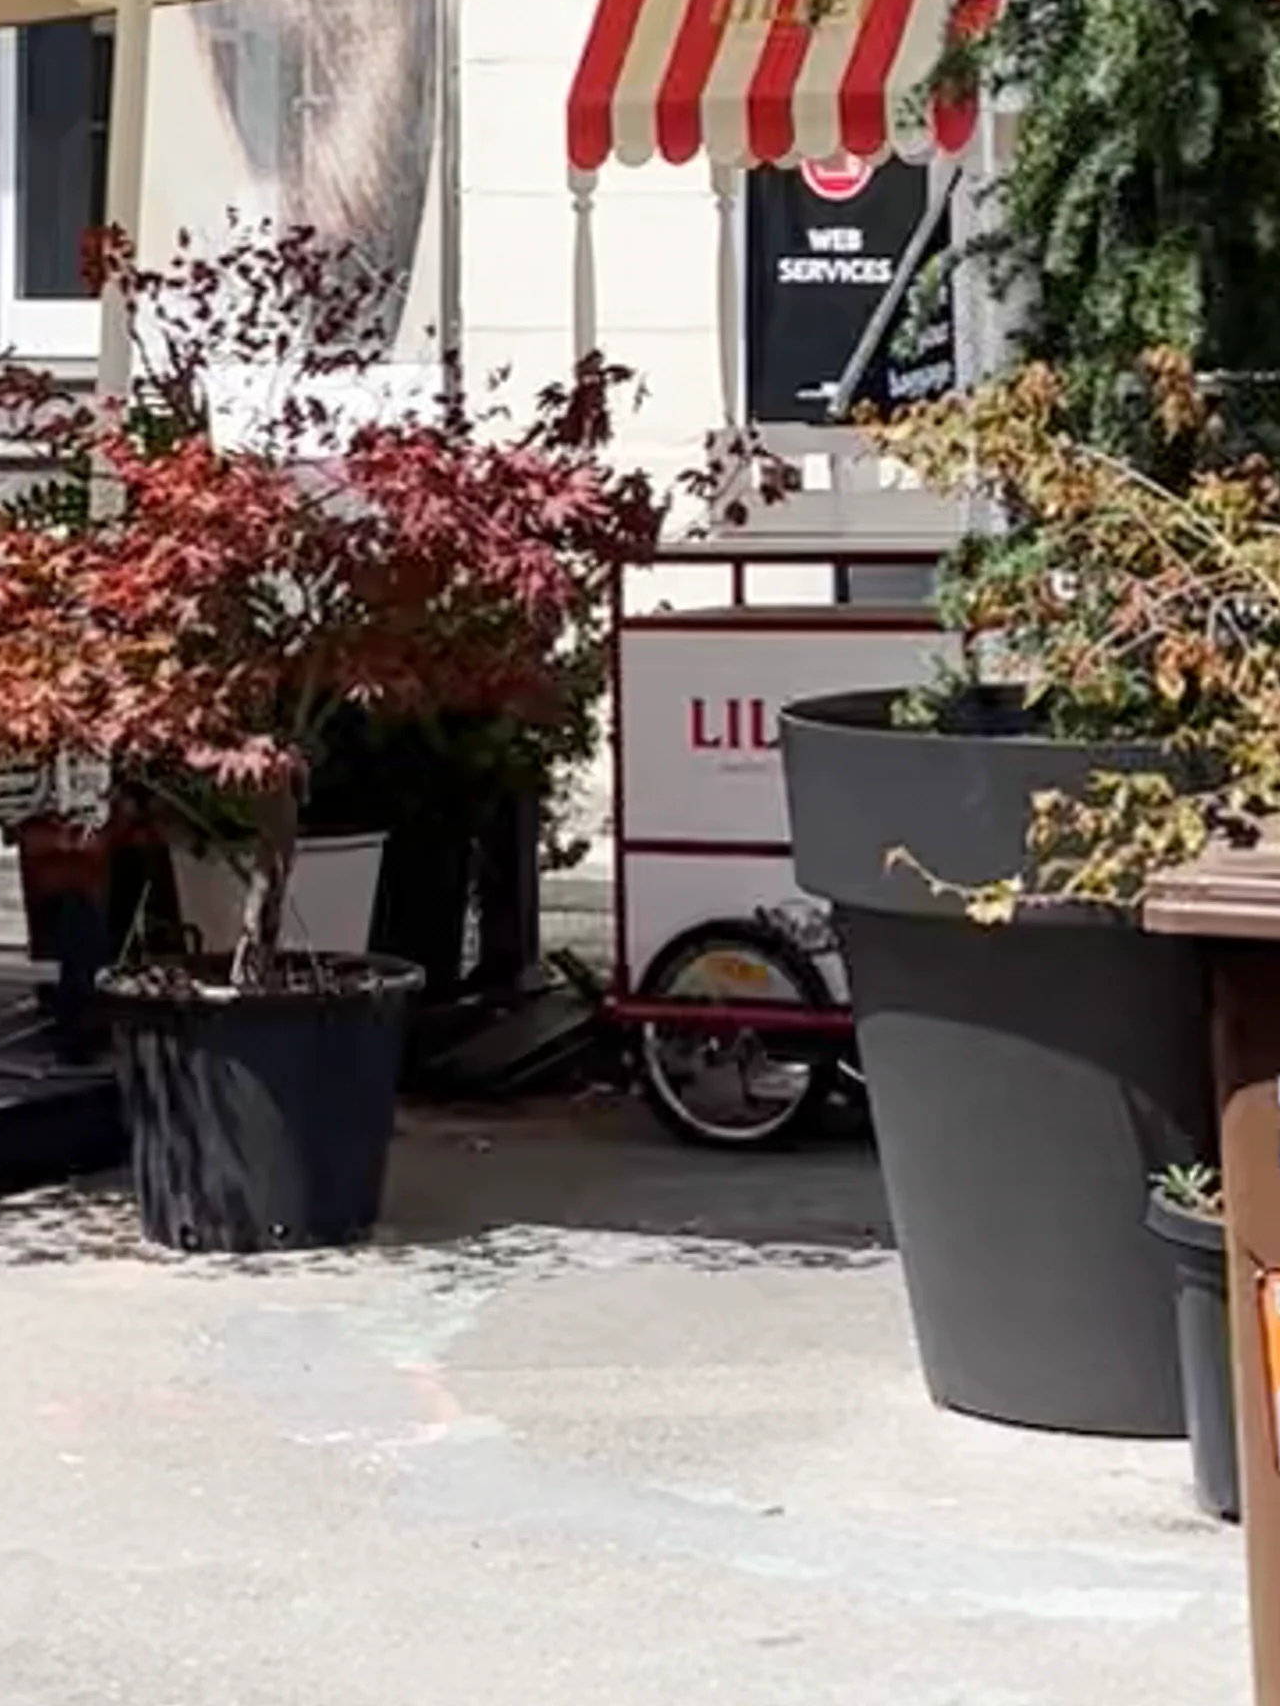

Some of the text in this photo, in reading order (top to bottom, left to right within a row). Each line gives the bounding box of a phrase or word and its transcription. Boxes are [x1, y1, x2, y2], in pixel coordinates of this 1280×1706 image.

[806, 227, 863, 252] WEB
[777, 257, 893, 284] SERVICES
[690, 697, 781, 750] LIL
